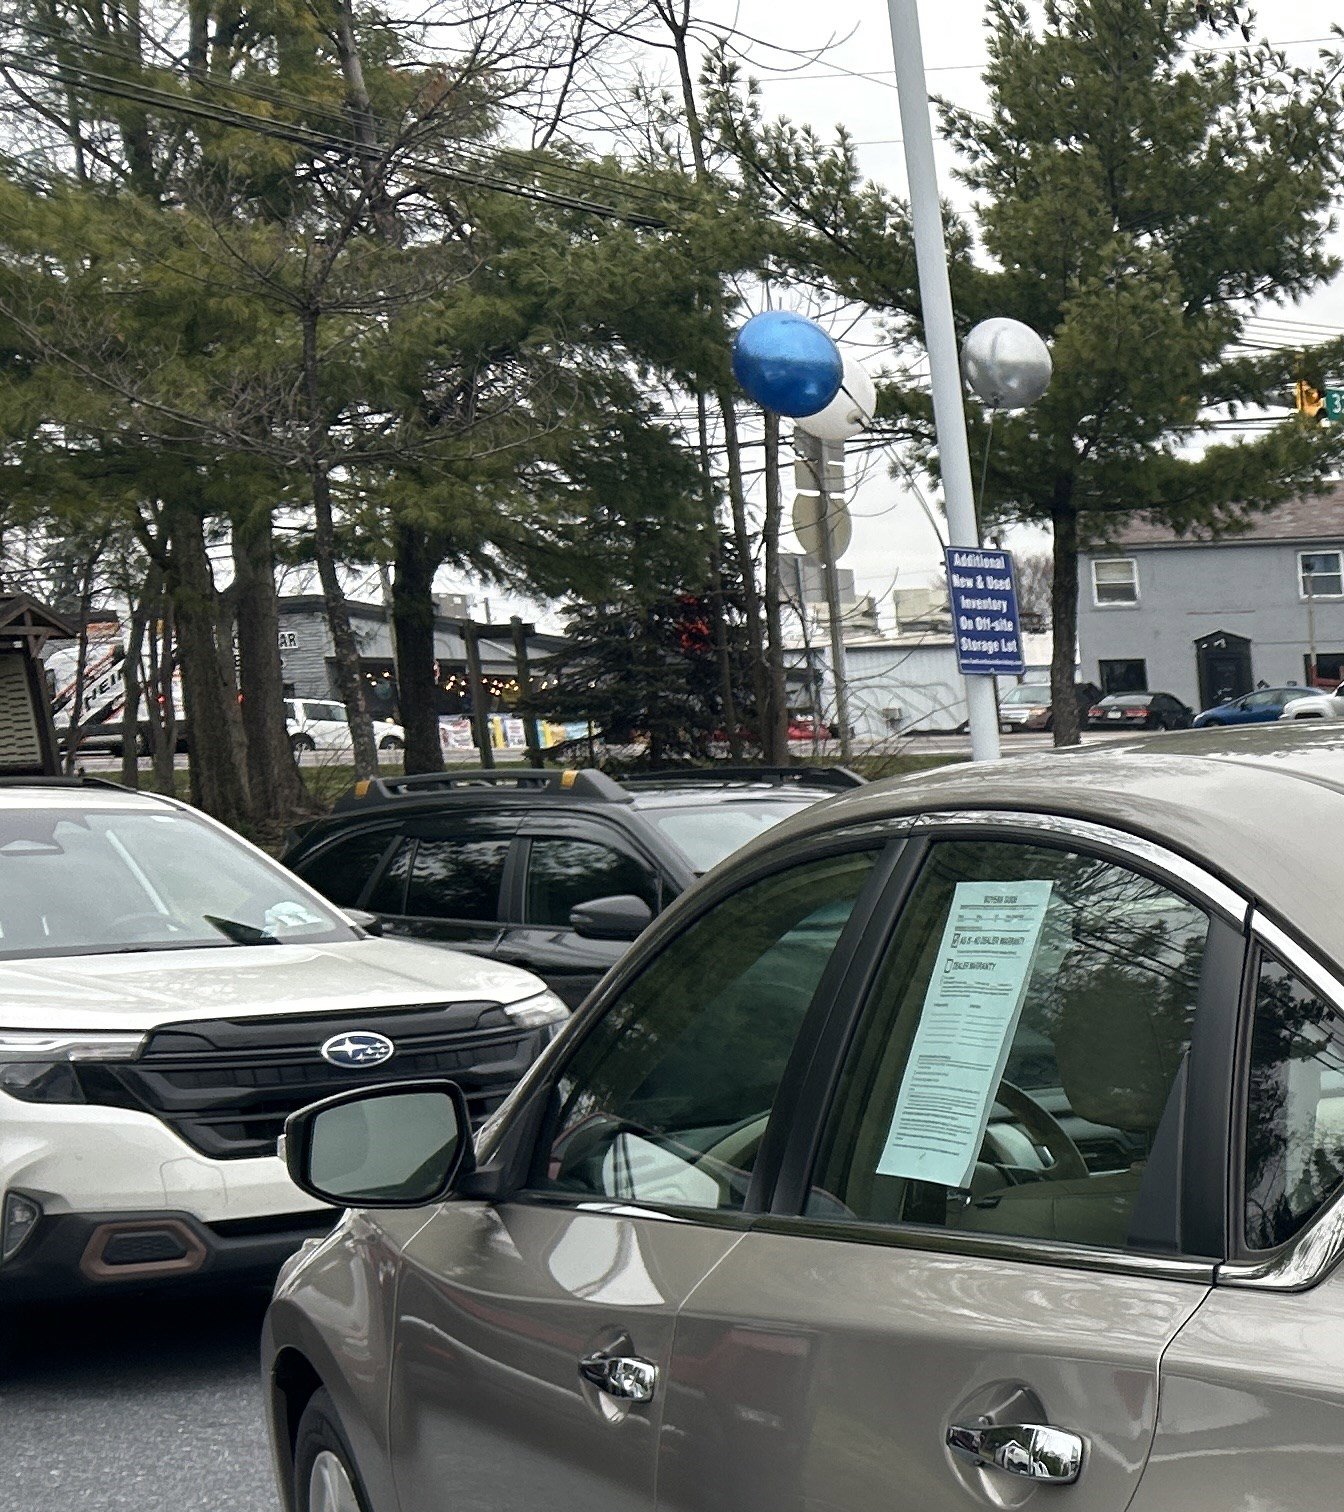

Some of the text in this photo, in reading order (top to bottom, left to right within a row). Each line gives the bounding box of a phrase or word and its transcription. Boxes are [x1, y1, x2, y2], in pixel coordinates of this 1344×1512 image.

[953, 553, 1005, 569] Additional
[952, 574, 1011, 591] New & Used
[960, 595, 1007, 613] Inventory
[960, 615, 1013, 632] On Off-site
[960, 637, 1017, 654] Storage Lot
